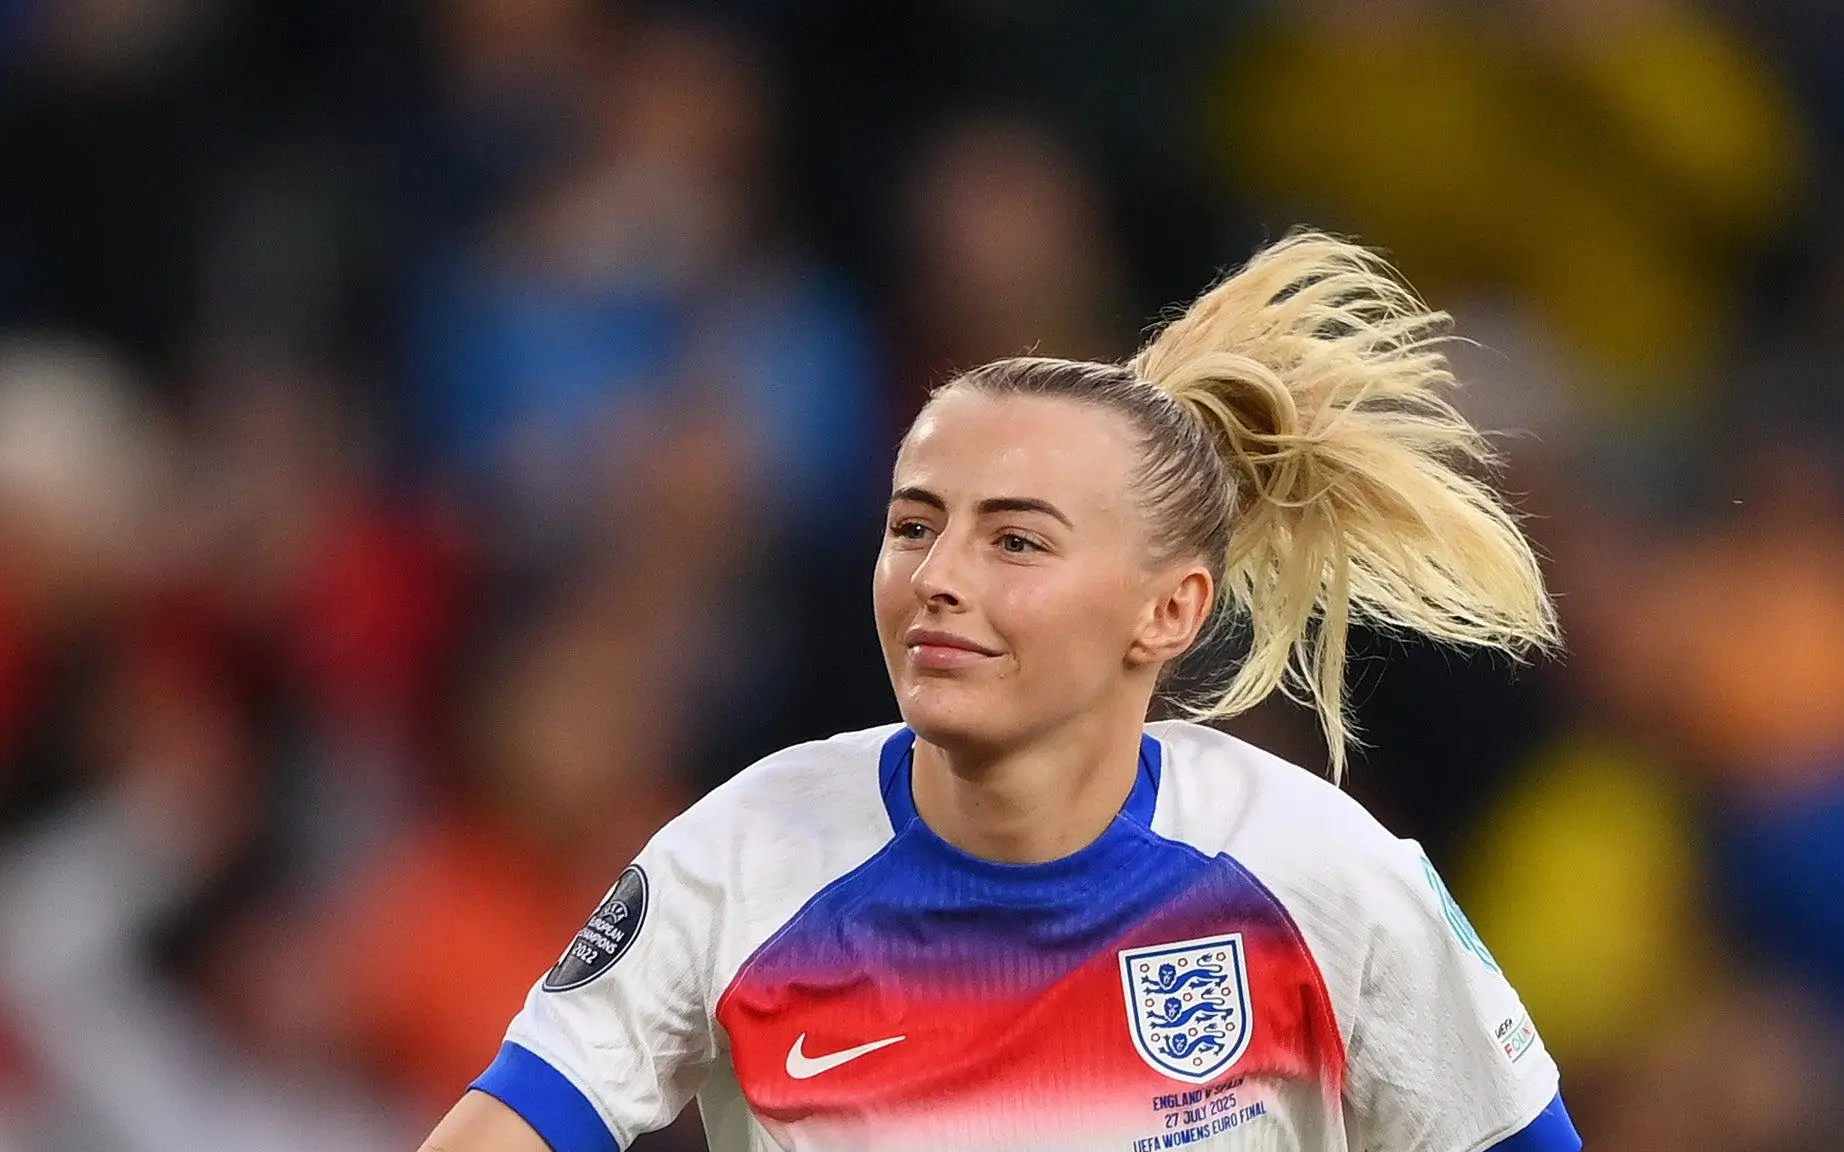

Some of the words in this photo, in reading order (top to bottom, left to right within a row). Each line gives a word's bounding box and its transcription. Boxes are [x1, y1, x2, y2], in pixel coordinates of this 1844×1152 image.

[588, 916, 625, 942] UROPEAN
[572, 942, 598, 965] 2022
[1152, 1089, 1203, 1112] ENGLAND
[1164, 1112, 1180, 1129] 27
[1183, 1105, 1208, 1125] JULY
[1210, 1093, 1238, 1116] 2025
[1162, 1124, 1211, 1149] WOMENS
[1211, 1112, 1239, 1134] EURO
[1239, 1101, 1268, 1124] FINAL
